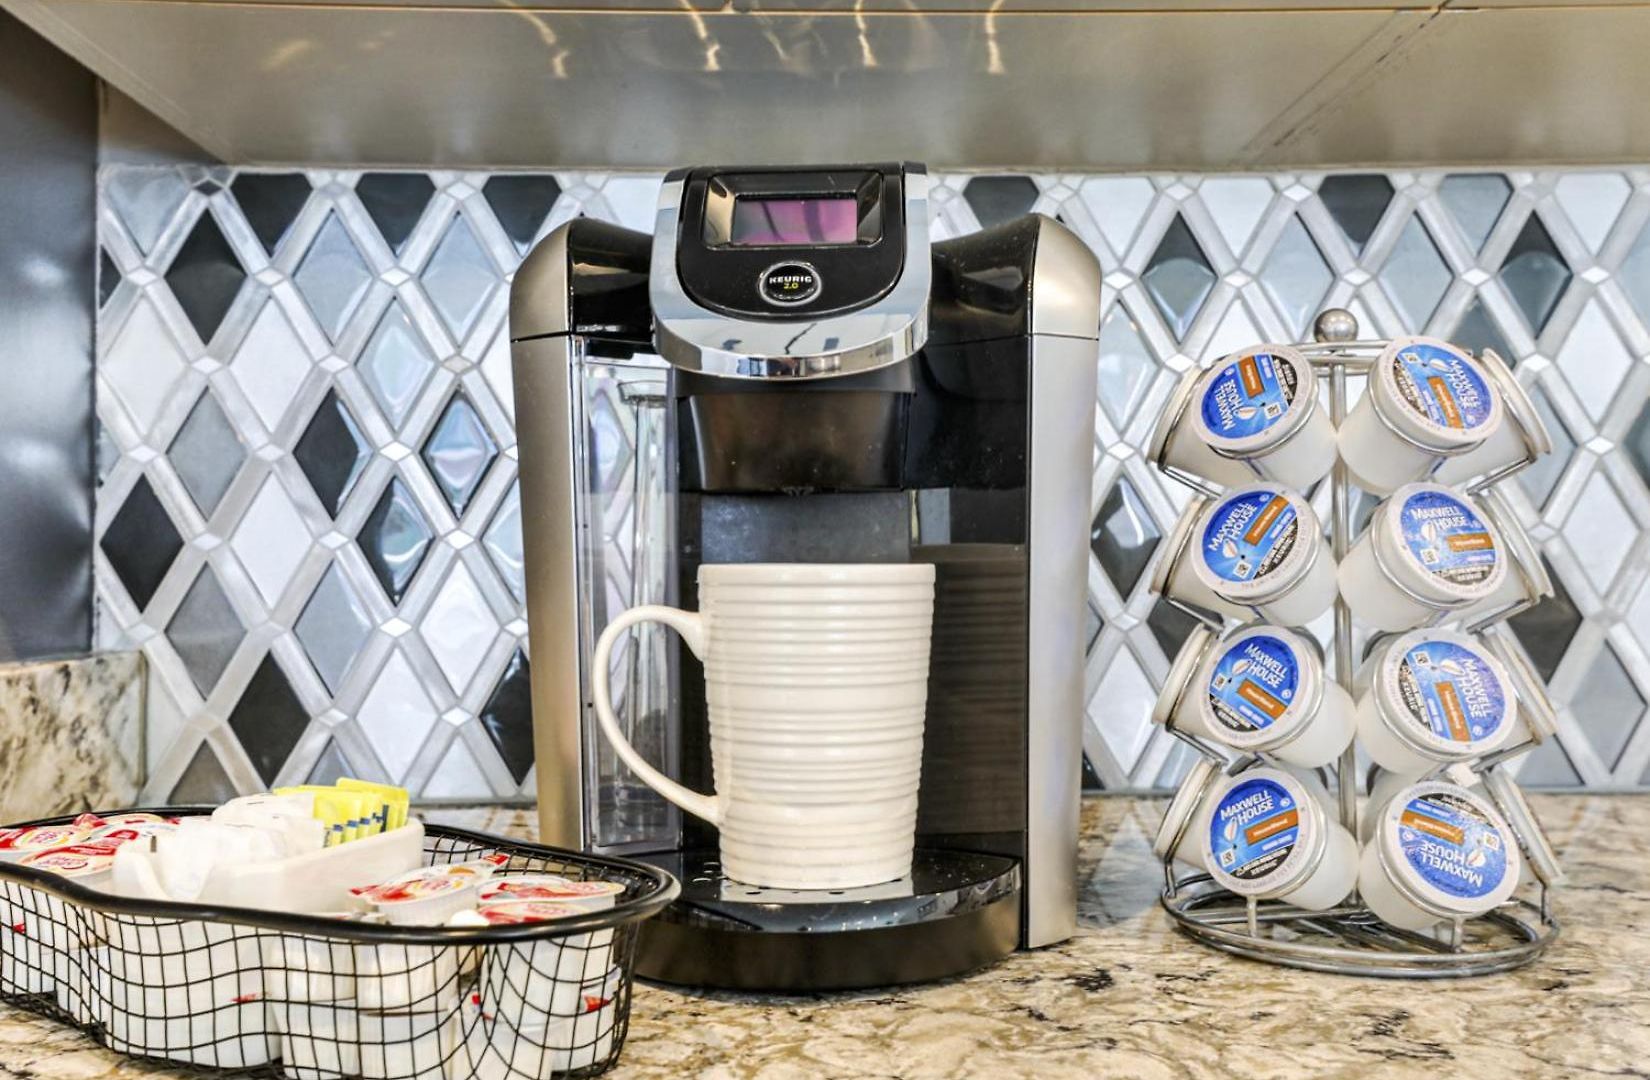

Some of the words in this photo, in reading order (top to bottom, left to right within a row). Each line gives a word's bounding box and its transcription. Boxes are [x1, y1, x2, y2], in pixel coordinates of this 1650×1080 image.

[769, 276, 812, 284] KEURIG
[1224, 379, 1244, 411] HOUSE
[1446, 373, 1470, 409] HOUSE
[1451, 360, 1480, 408] MAXWELL
[1215, 388, 1236, 431] MAXWELL
[1208, 503, 1248, 551] MAXWELL
[1228, 504, 1257, 539] HOUSE
[1409, 506, 1463, 520] MAXWELL
[1432, 516, 1465, 529] HOUSE
[1244, 643, 1288, 679] MAXWELL
[1247, 661, 1282, 689] HOUSE
[1455, 674, 1483, 718] HOUSE
[1462, 658, 1492, 717] MAXWELL
[1220, 789, 1272, 821] MAXWELL
[1237, 800, 1275, 825] HOUSE
[1420, 840, 1465, 865] HOUSE
[1420, 850, 1483, 887] MAXWELL
